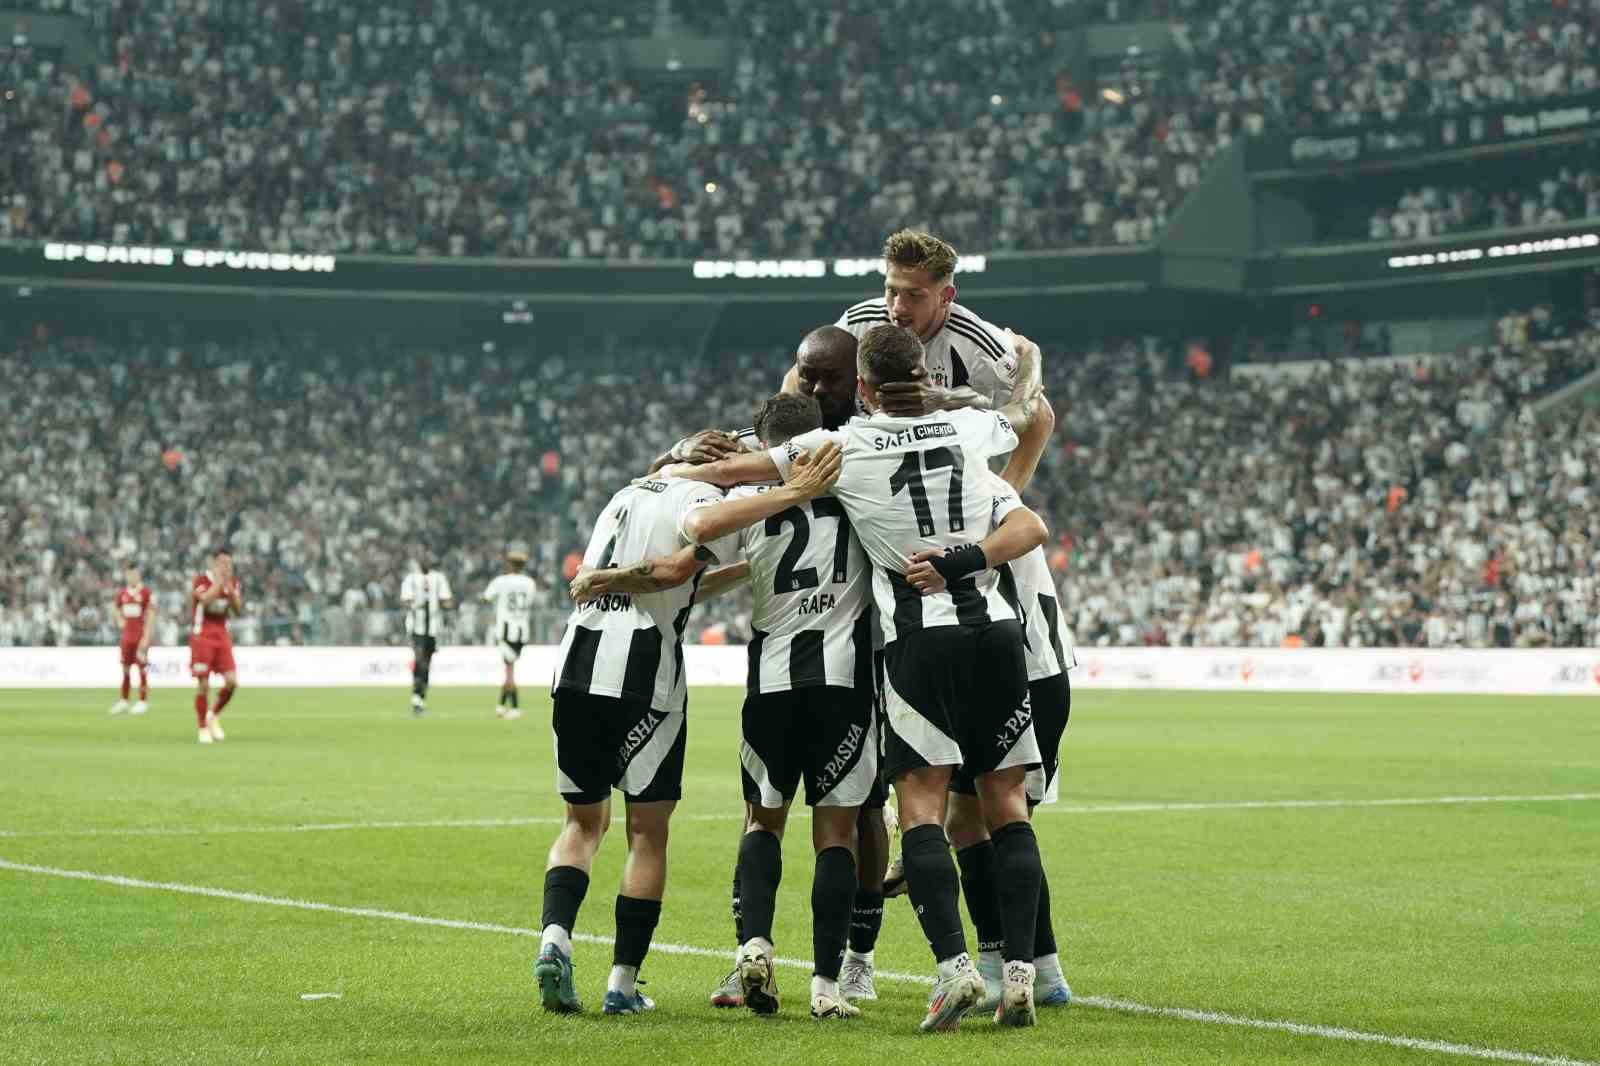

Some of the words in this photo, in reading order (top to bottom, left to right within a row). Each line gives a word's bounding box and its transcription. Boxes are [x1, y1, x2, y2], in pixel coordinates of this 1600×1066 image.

[889, 445, 964, 538] 17
[765, 496, 850, 595] 27
[799, 593, 836, 615] RAFA
[619, 712, 660, 762] PASHA
[1005, 689, 1032, 735] PAS
[824, 723, 863, 779] PASHA
